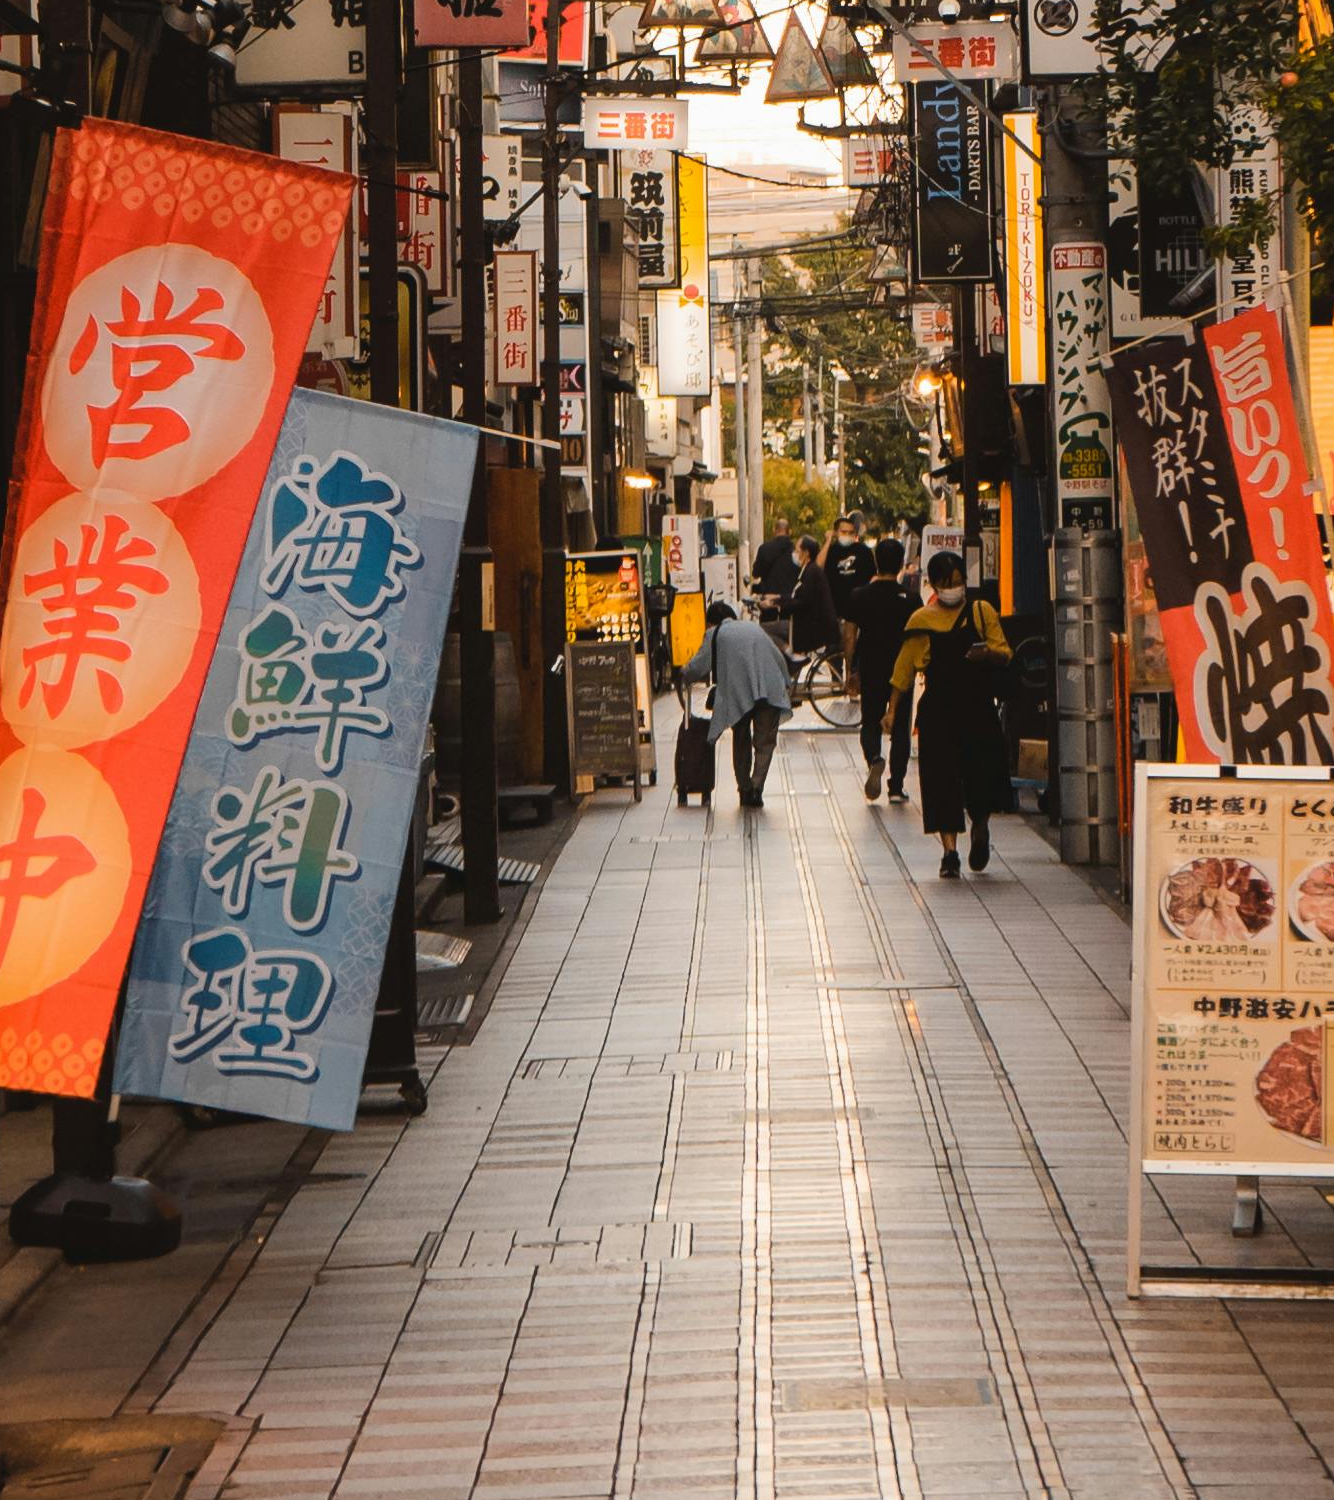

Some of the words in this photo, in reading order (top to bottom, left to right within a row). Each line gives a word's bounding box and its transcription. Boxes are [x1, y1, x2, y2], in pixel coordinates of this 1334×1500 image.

[908, 37, 997, 70] 三番街
[597, 112, 676, 140] 三番街
[967, 105, 981, 139] BAR
[1019, 172, 1034, 317] TORIKIZOKU
[503, 269, 528, 370] 三番街
[1173, 357, 1236, 561] スタミナ
[167, 452, 421, 1084] 海鮮料理
[1168, 795, 1267, 816] 和牛盛り
